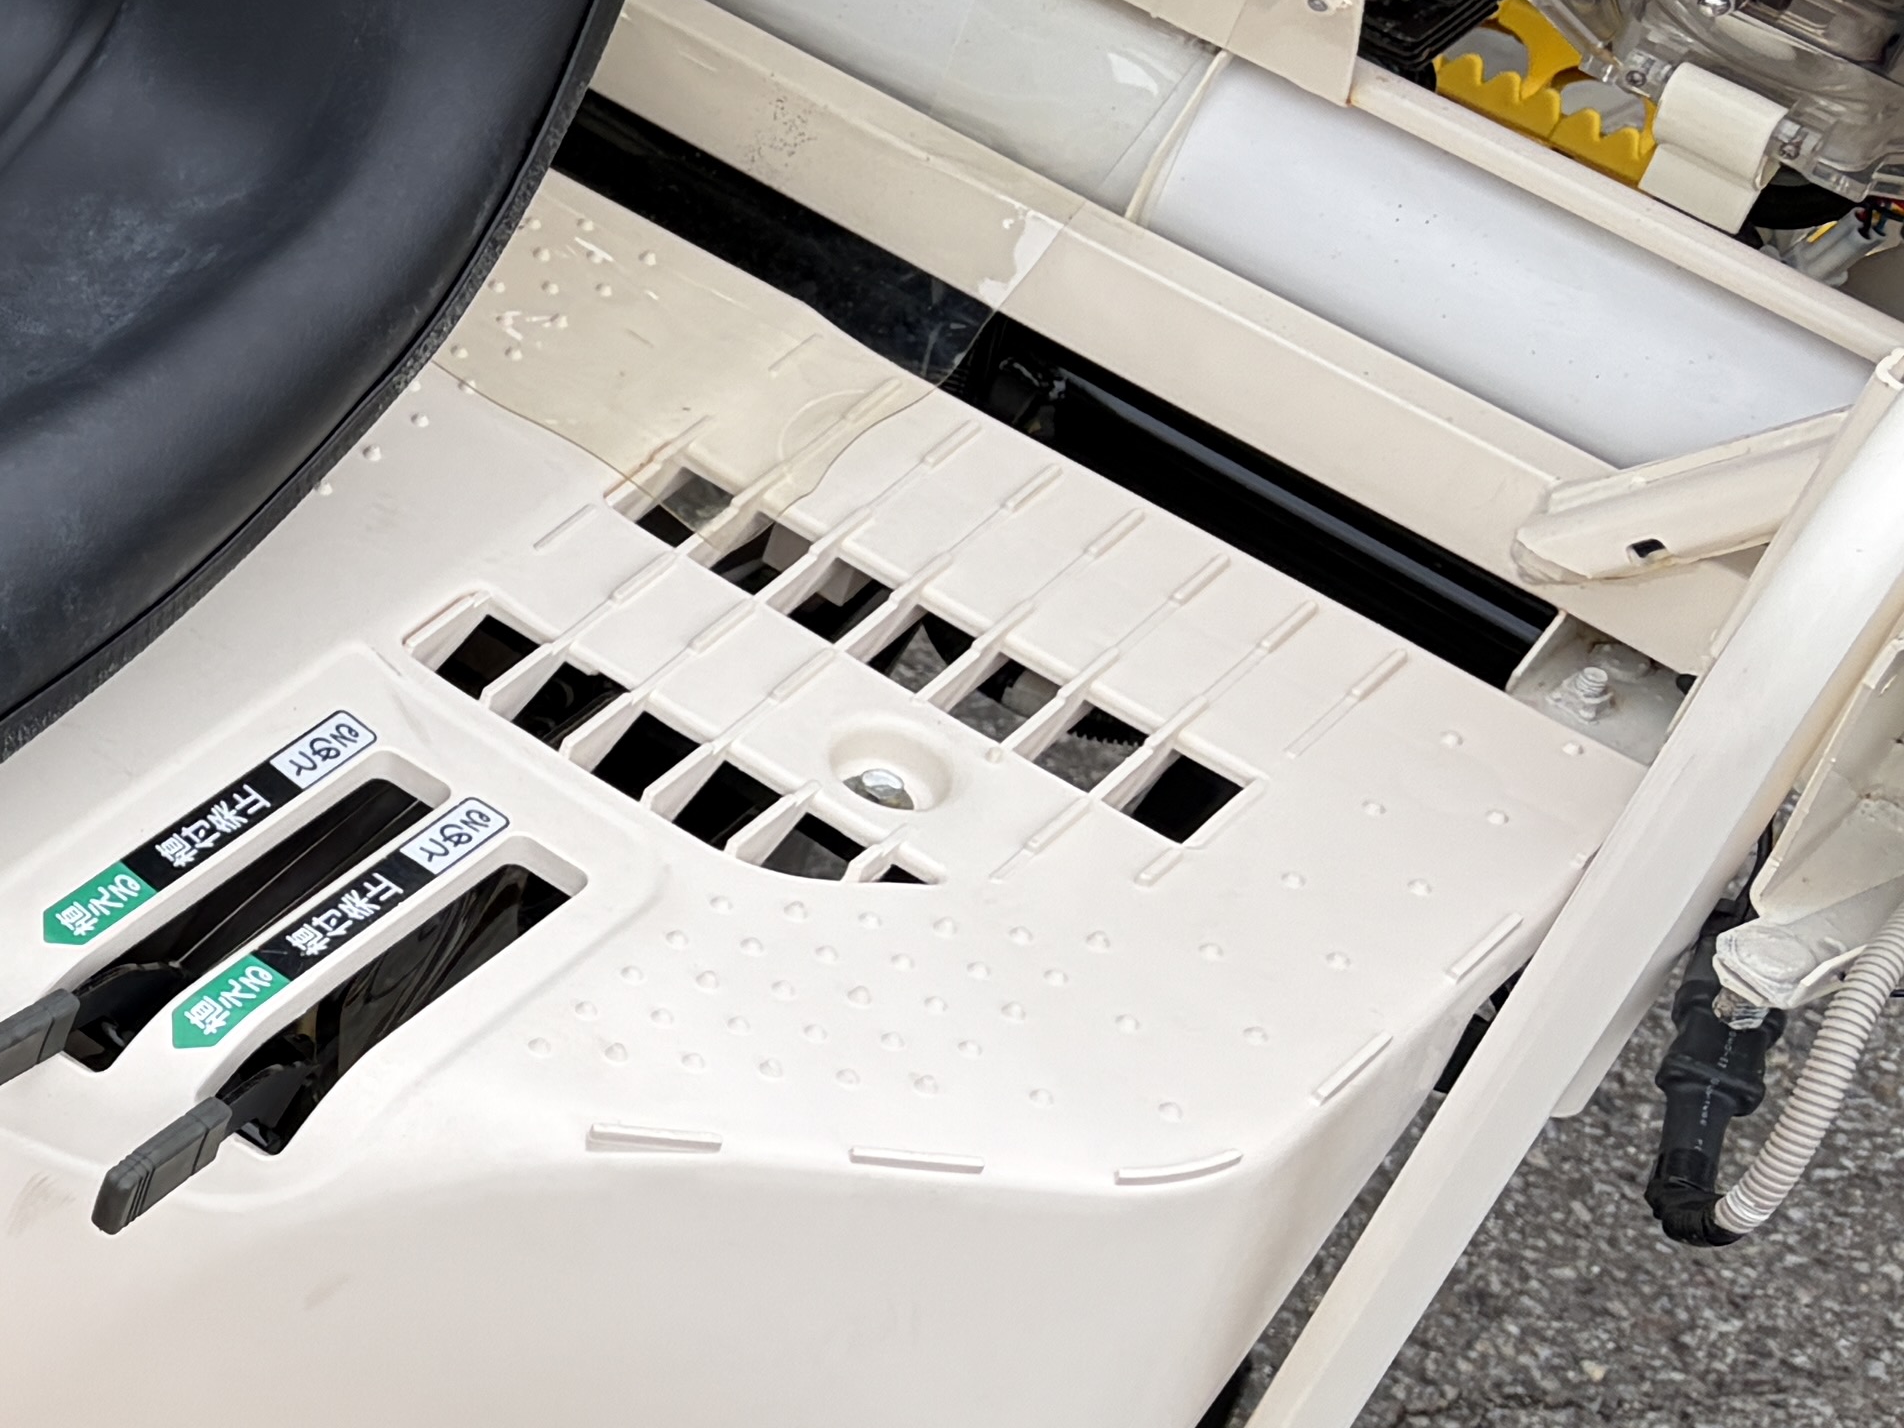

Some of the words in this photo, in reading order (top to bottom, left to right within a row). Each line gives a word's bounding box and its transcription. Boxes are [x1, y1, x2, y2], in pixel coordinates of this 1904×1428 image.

[288, 722, 360, 778] とめる
[155, 784, 271, 868] 植付条止
[425, 807, 492, 863] とめる
[54, 872, 142, 936] 植える
[285, 872, 403, 957] 植付条止
[183, 964, 274, 1035] 植える
